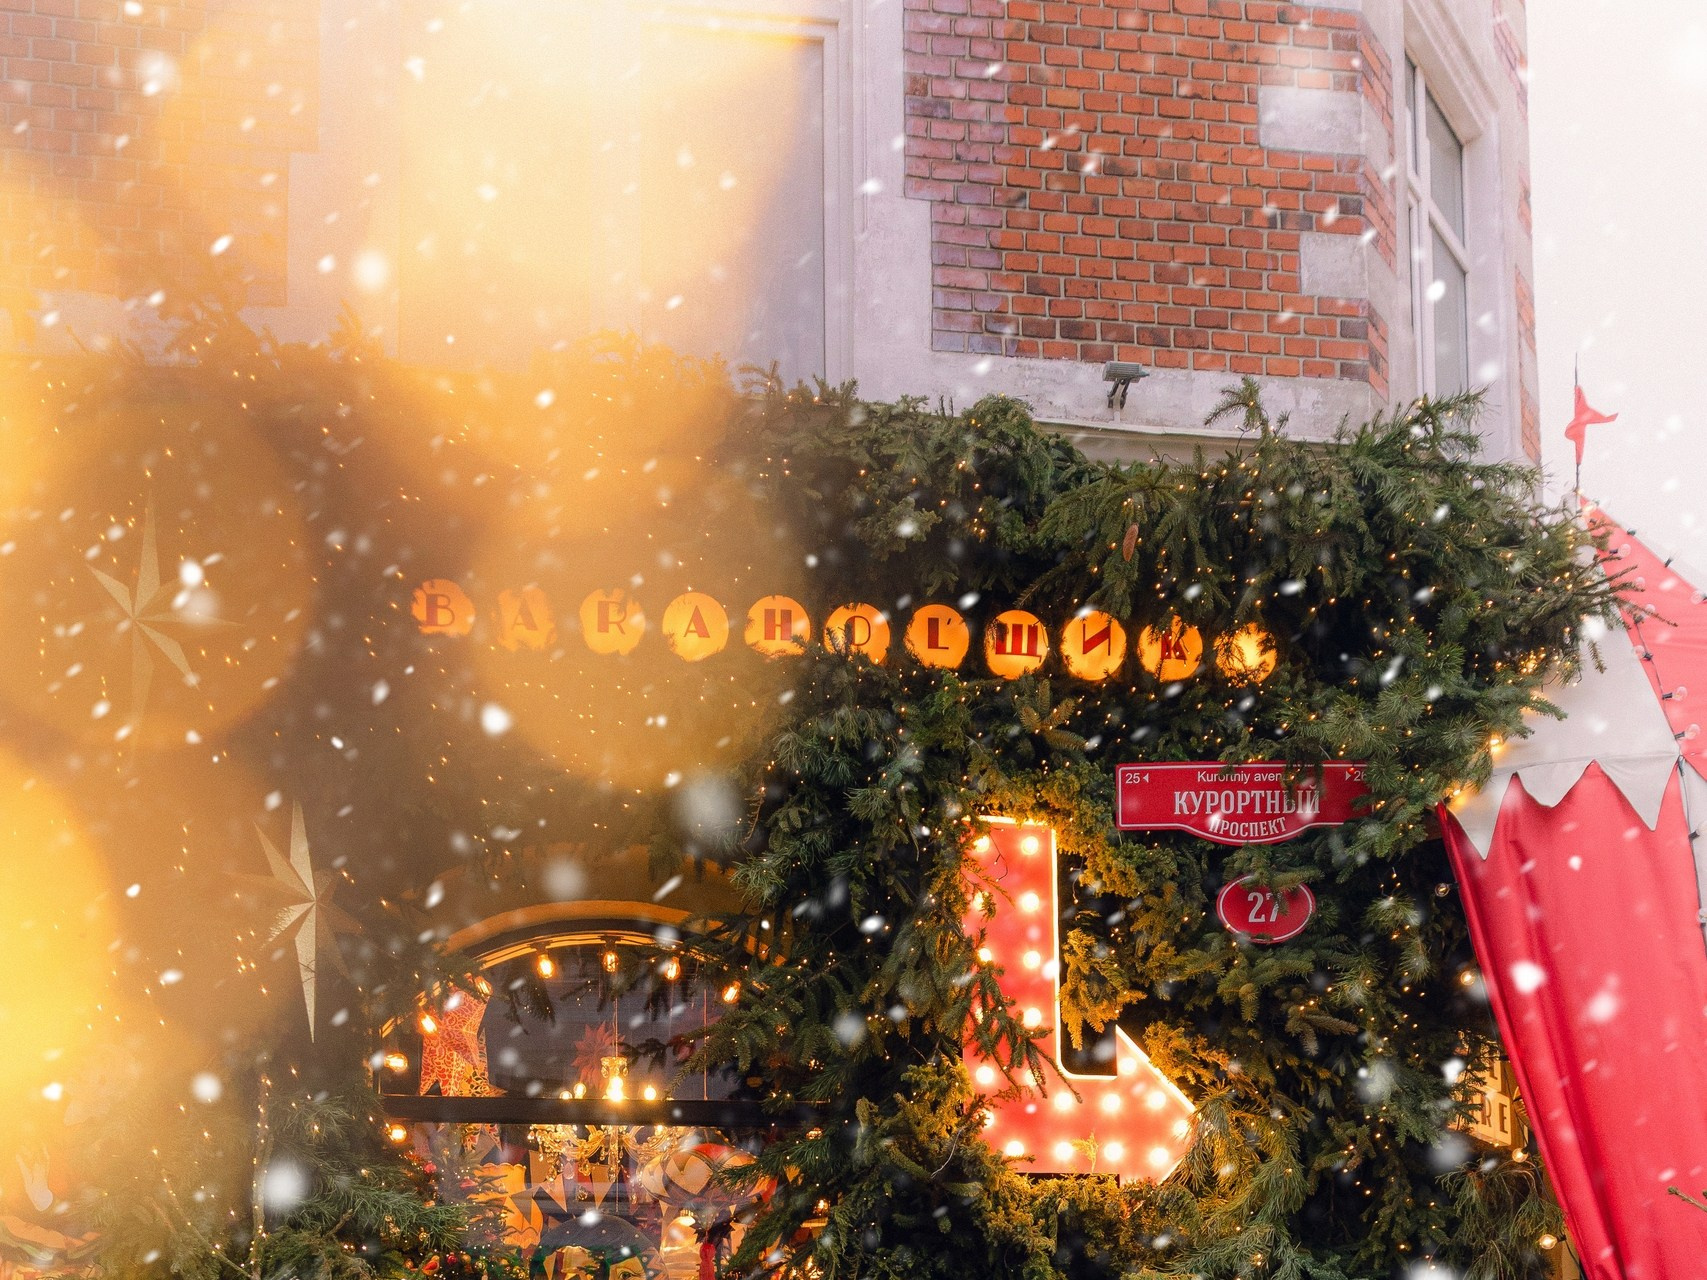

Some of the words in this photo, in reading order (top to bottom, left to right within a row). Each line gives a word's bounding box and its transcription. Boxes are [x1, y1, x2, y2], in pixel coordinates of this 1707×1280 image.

[1125, 772, 1141, 784] 25
[1197, 770, 1250, 785] Kurortniy
[1253, 773, 1291, 783] aven
[1173, 784, 1321, 815] КУРОРТНЫЙ
[1209, 816, 1287, 838] ПРОСПЕКТ
[1247, 891, 1282, 923] 27
